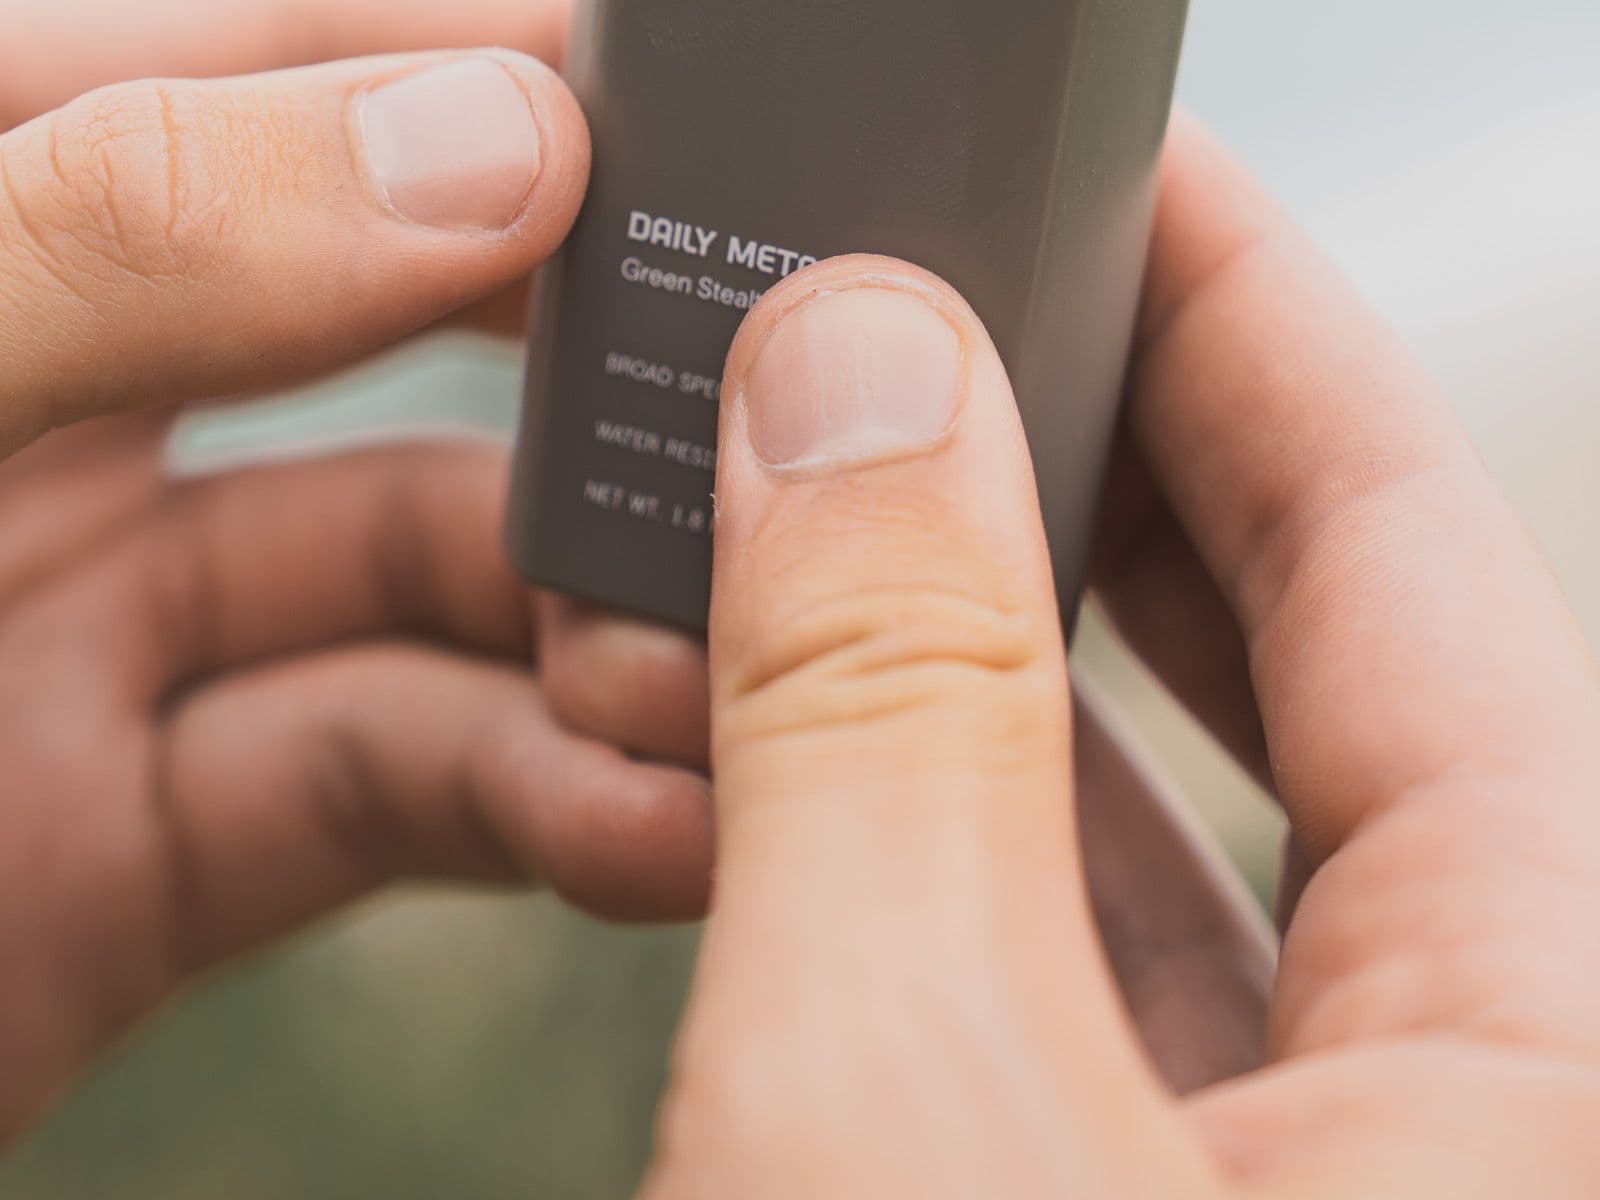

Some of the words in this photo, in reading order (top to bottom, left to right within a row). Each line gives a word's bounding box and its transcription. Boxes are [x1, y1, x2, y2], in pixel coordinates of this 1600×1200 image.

[627, 210, 718, 257] DAILY
[620, 256, 693, 294] Green
[696, 276, 761, 310] Steal
[605, 352, 674, 387] BROAD
[595, 421, 660, 454] WATER
[584, 479, 624, 508] NET
